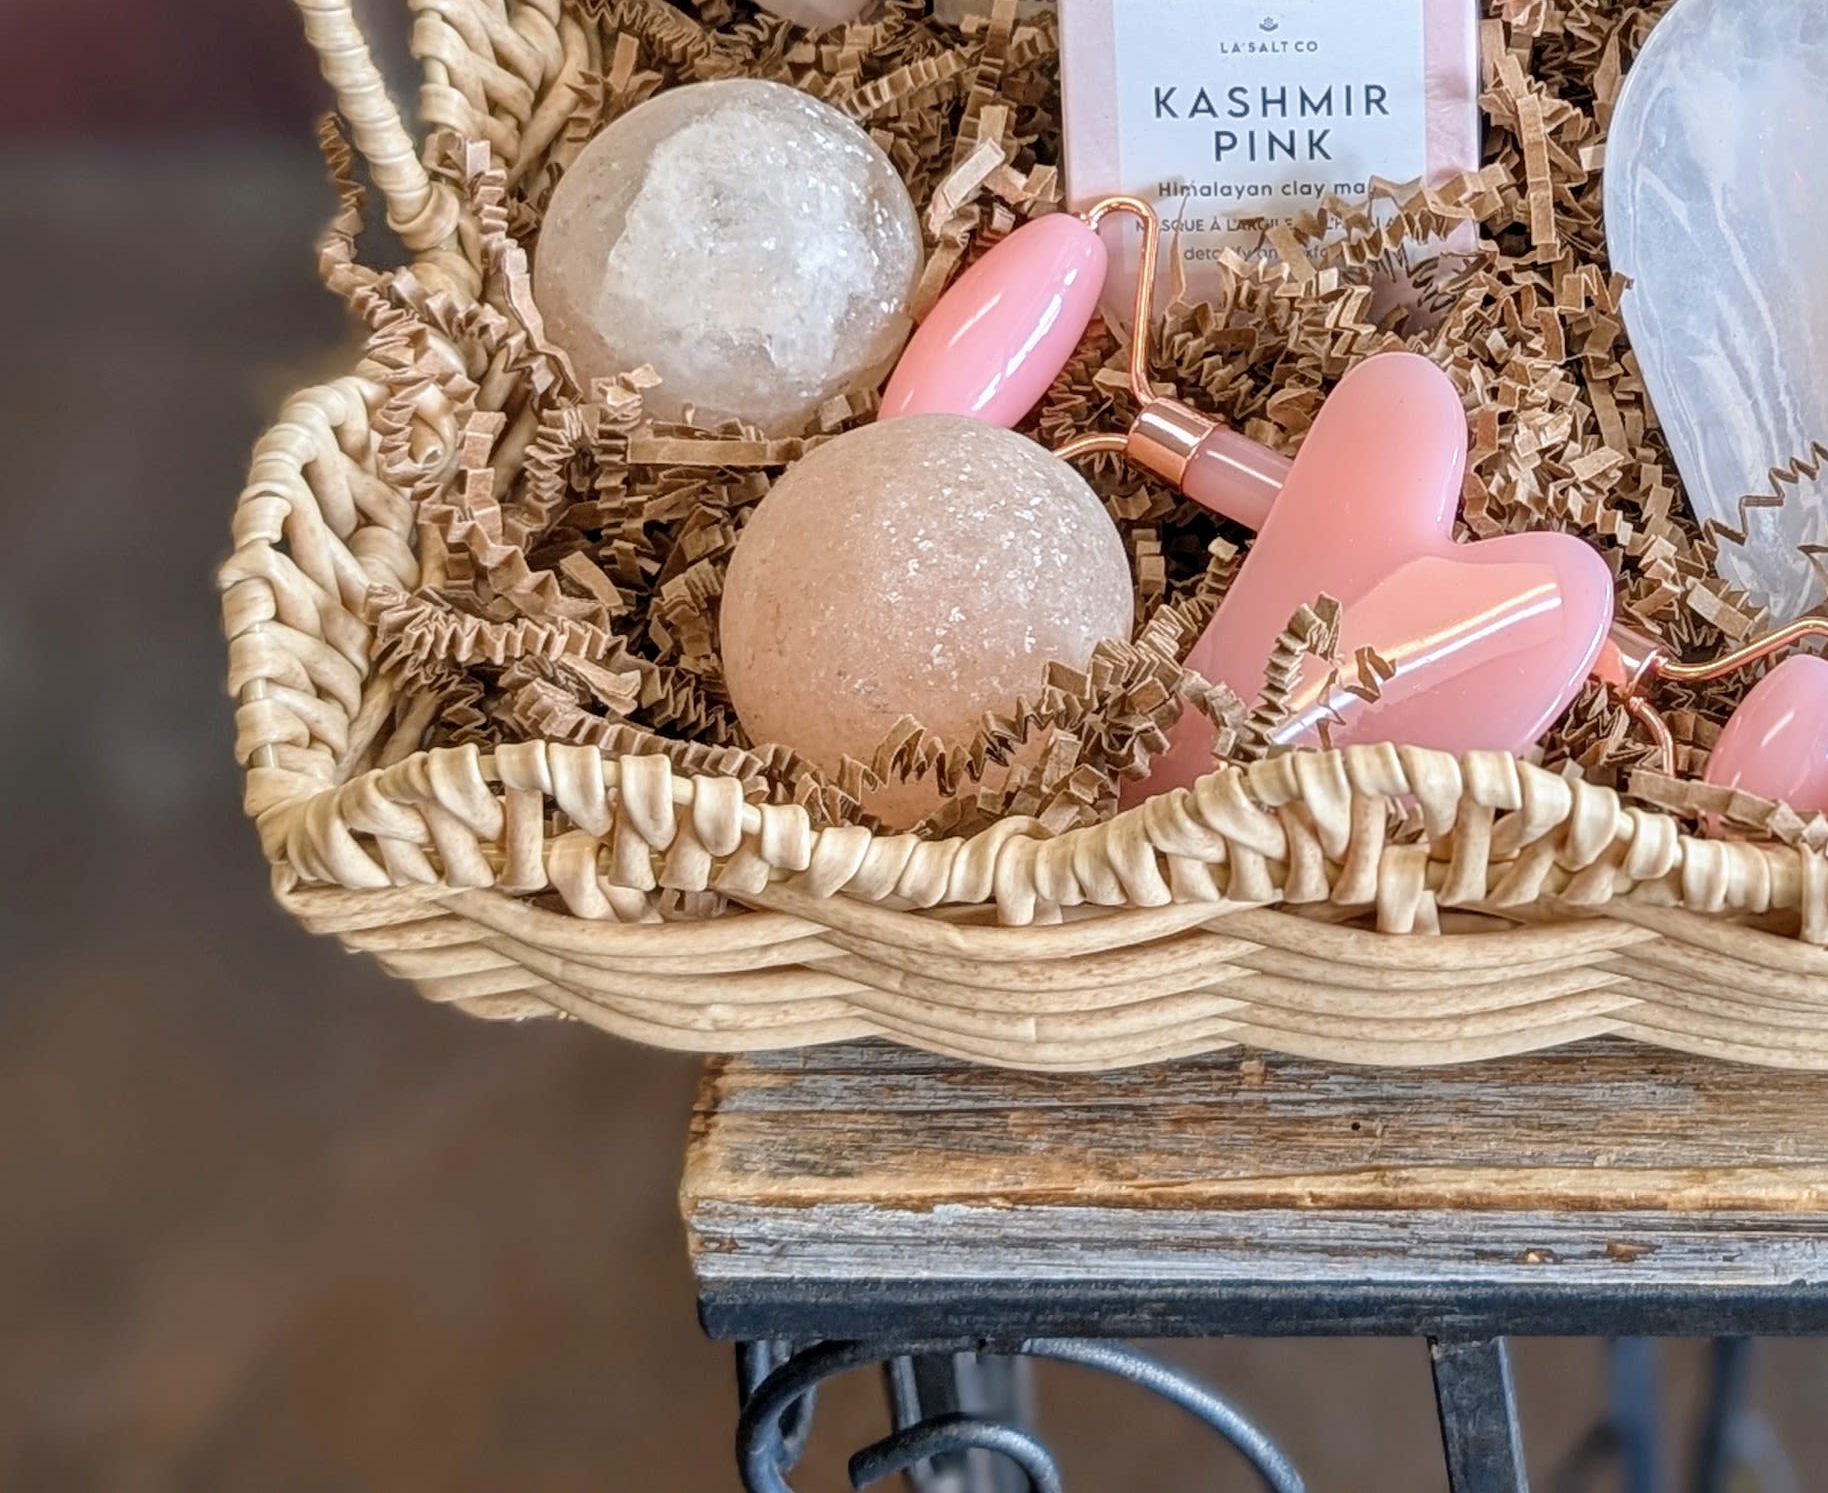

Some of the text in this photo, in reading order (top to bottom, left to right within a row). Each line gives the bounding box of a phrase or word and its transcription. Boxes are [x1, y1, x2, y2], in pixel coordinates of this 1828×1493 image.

[1219, 40, 1319, 54] LA SALT CO
[1154, 83, 1390, 119] KASHMIR
[1214, 128, 1333, 163] PINK
[1158, 180, 1272, 200] Himalayan
[1280, 180, 1325, 199] clay
[1209, 215, 1222, 232] À
